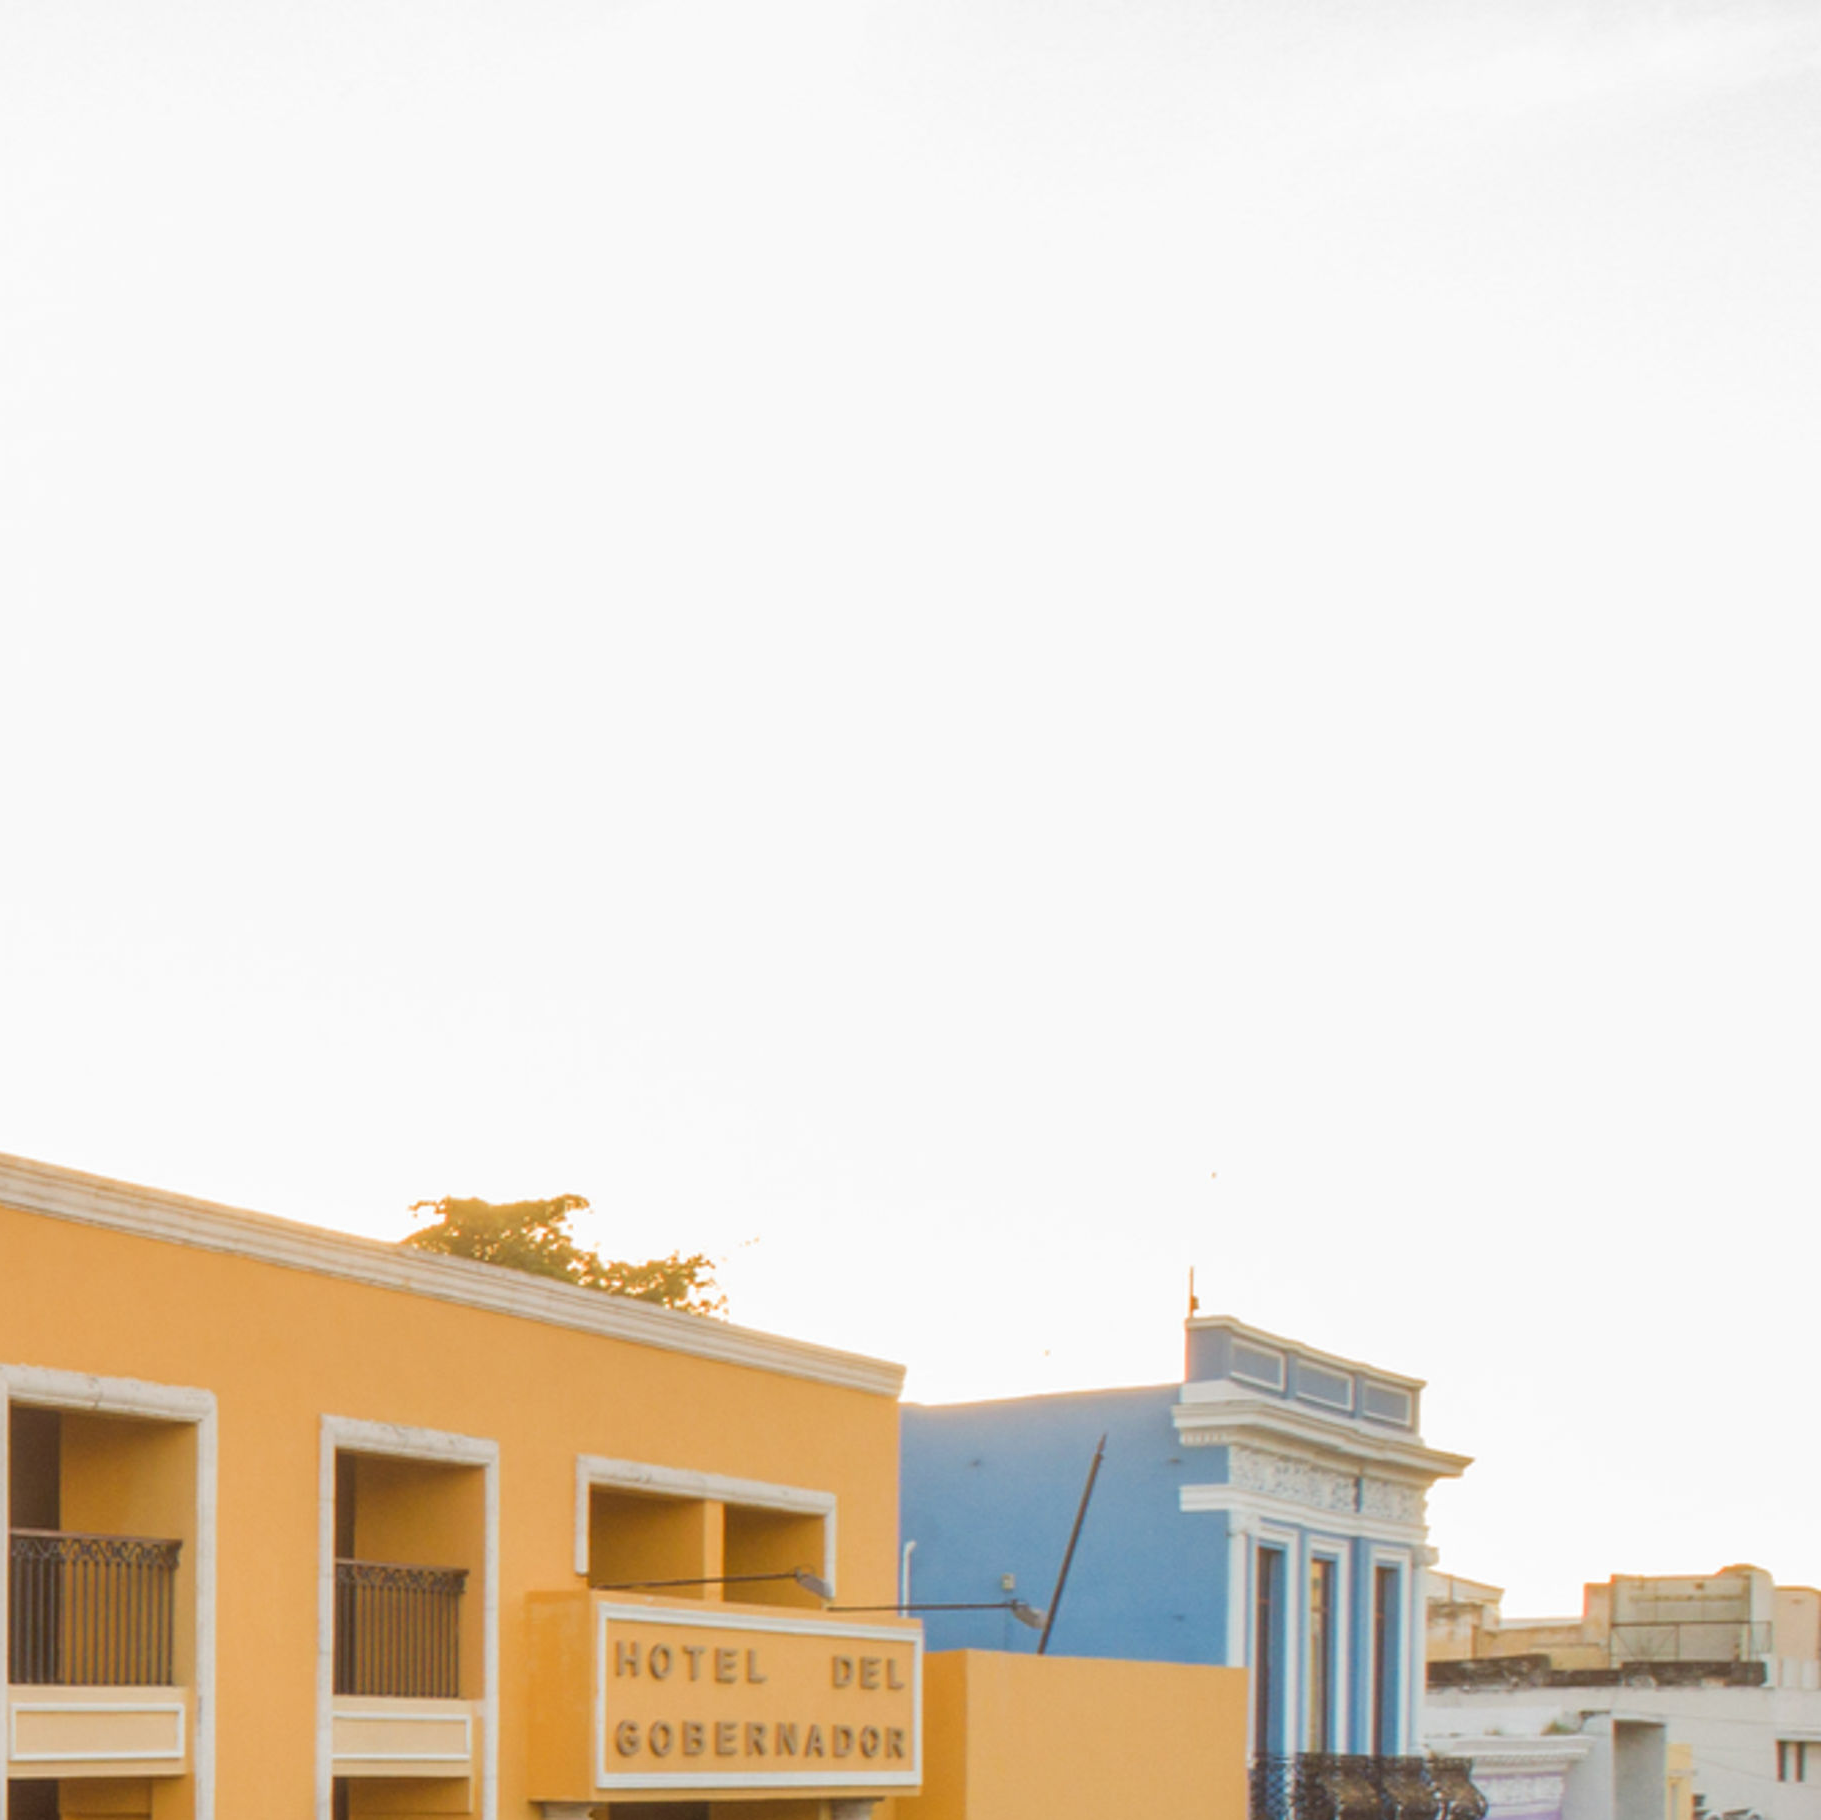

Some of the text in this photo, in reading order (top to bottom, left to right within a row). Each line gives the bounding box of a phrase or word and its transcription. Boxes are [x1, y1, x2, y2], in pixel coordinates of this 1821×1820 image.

[614, 1640, 906, 1690] HOTEL DEL
[614, 1719, 907, 1760] GOBERNADOR
